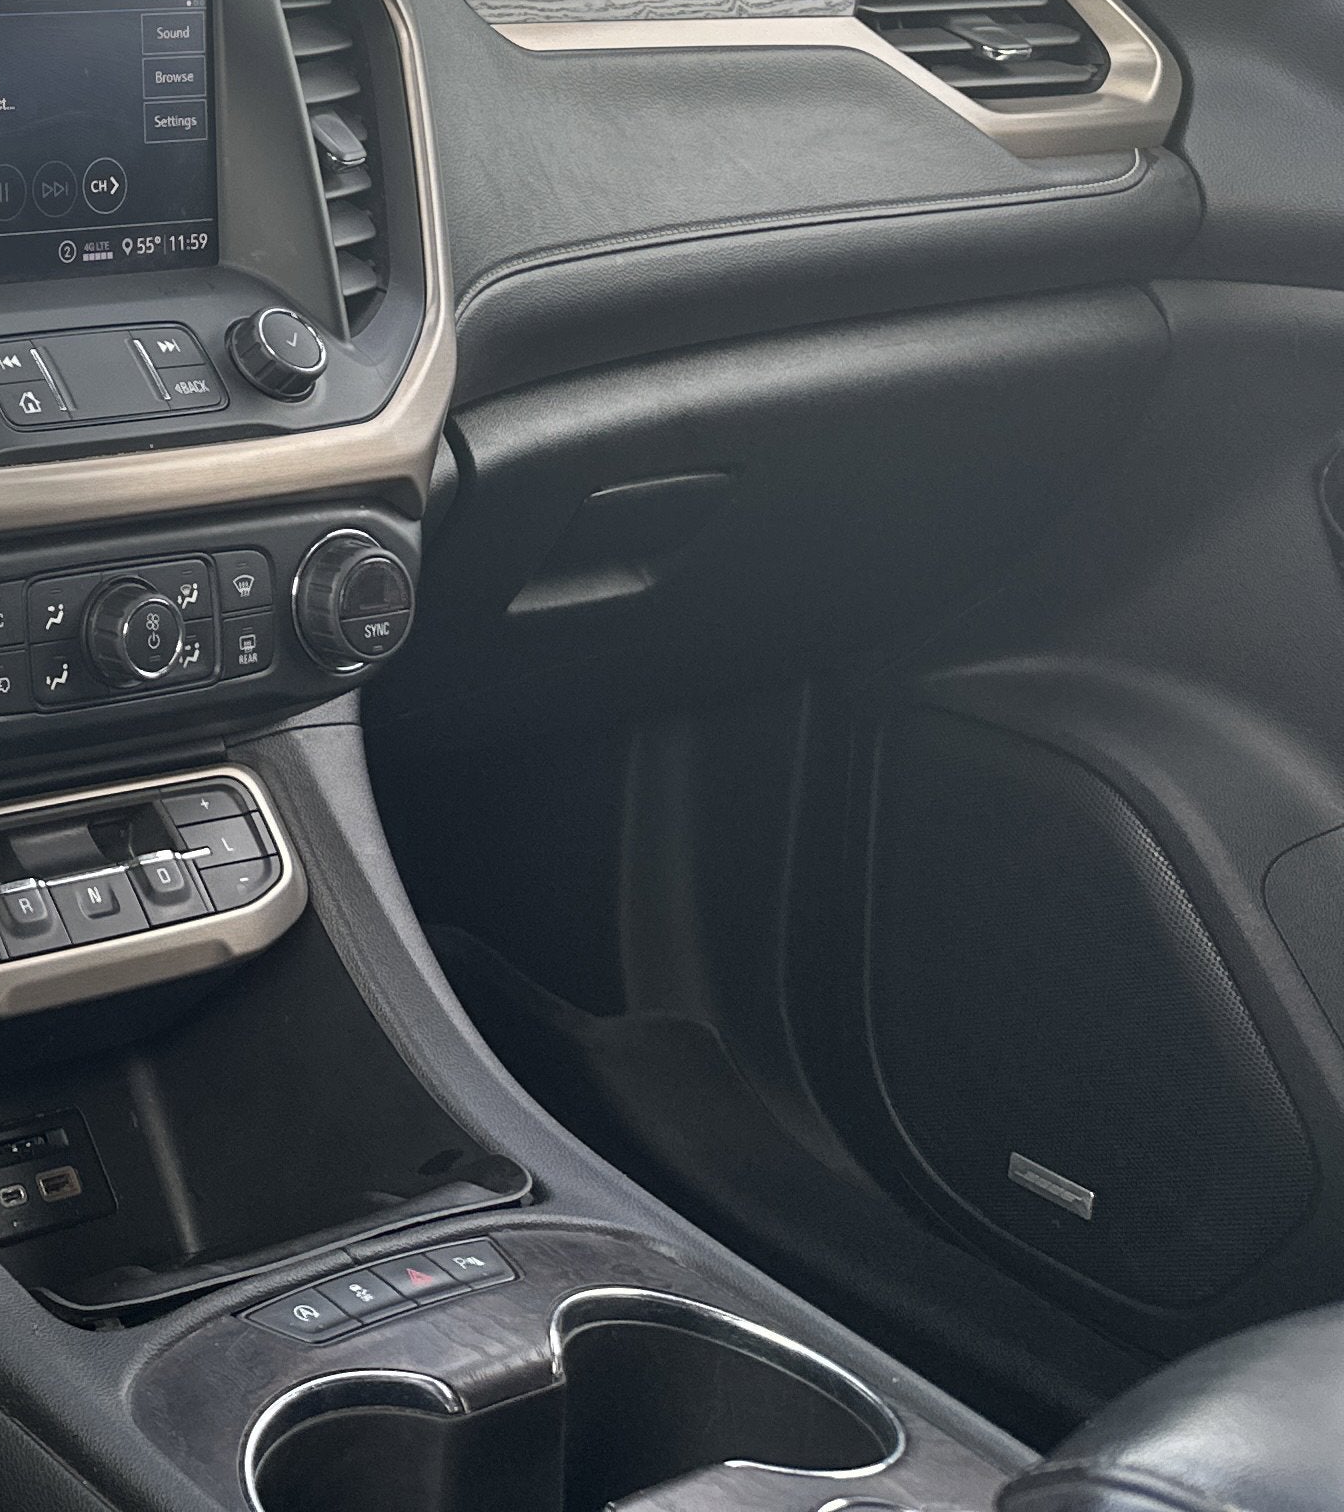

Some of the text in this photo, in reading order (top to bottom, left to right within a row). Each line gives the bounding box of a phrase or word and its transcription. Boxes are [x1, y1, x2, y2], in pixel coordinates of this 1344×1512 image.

[156, 26, 190, 39] Sound
[155, 71, 194, 84] Browse
[154, 114, 197, 130] Settings
[90, 180, 108, 193] CH
[96, 241, 110, 251] LTE
[169, 233, 208, 251] 11:59
[179, 379, 211, 395] BACK
[364, 621, 390, 638] SYNC
[238, 652, 258, 664] REAR
[221, 838, 234, 852] L
[158, 868, 171, 883] D
[87, 886, 102, 904] N
[18, 897, 34, 914] R
